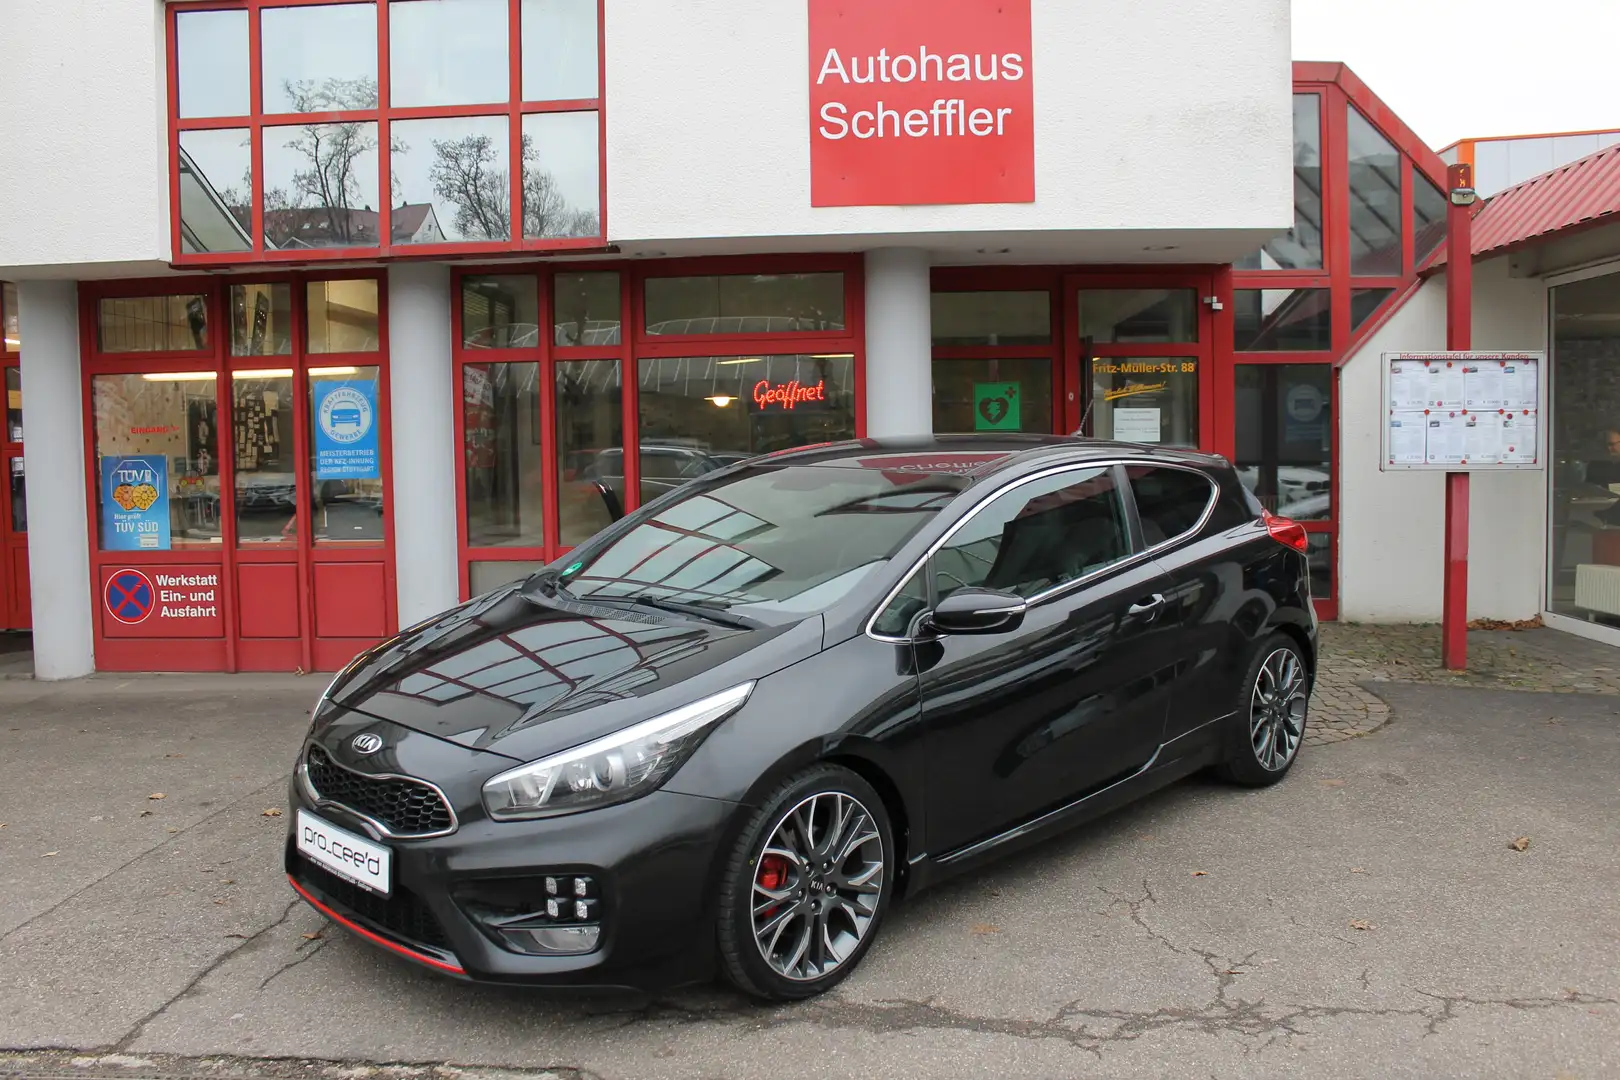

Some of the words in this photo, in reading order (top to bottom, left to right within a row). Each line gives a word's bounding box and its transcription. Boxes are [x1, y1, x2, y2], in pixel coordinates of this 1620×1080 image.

[816, 45, 1024, 85] Autohaus
[818, 99, 1012, 140] Scheffler
[1093, 362, 1178, 373] Fritz-Müller-Str.
[1181, 362, 1195, 373] 88
[753, 379, 825, 409] Geöffnet
[117, 469, 145, 483] TÜV
[114, 520, 135, 533] TÜV
[137, 520, 159, 533] SÜD
[156, 574, 218, 586] Werkstatt
[160, 590, 186, 602] Ein-
[189, 589, 215, 602] und
[161, 605, 217, 617] Ausfahrt
[354, 734, 377, 751] KIA
[810, 881, 823, 891] KIA
